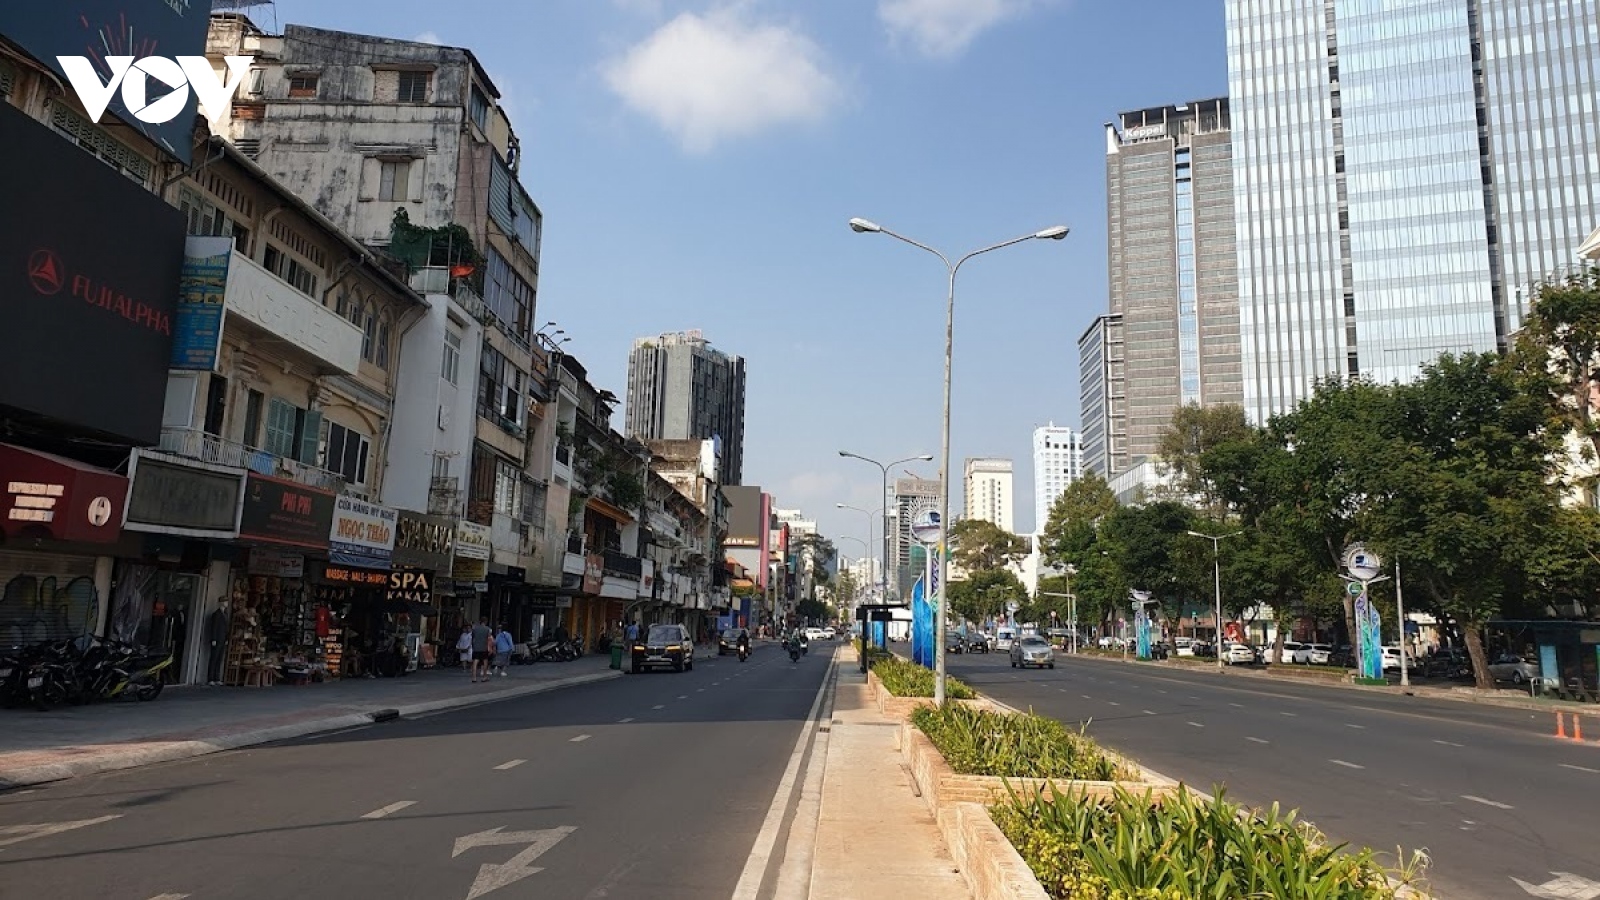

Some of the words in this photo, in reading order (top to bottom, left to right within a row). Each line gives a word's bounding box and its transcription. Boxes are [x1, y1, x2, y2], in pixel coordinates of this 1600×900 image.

[1126, 124, 1162, 137] Keppel
[337, 517, 365, 543] NGỌC
[366, 520, 390, 545] THẢO
[389, 572, 429, 590] SPA
[387, 590, 430, 603] KAKA2
